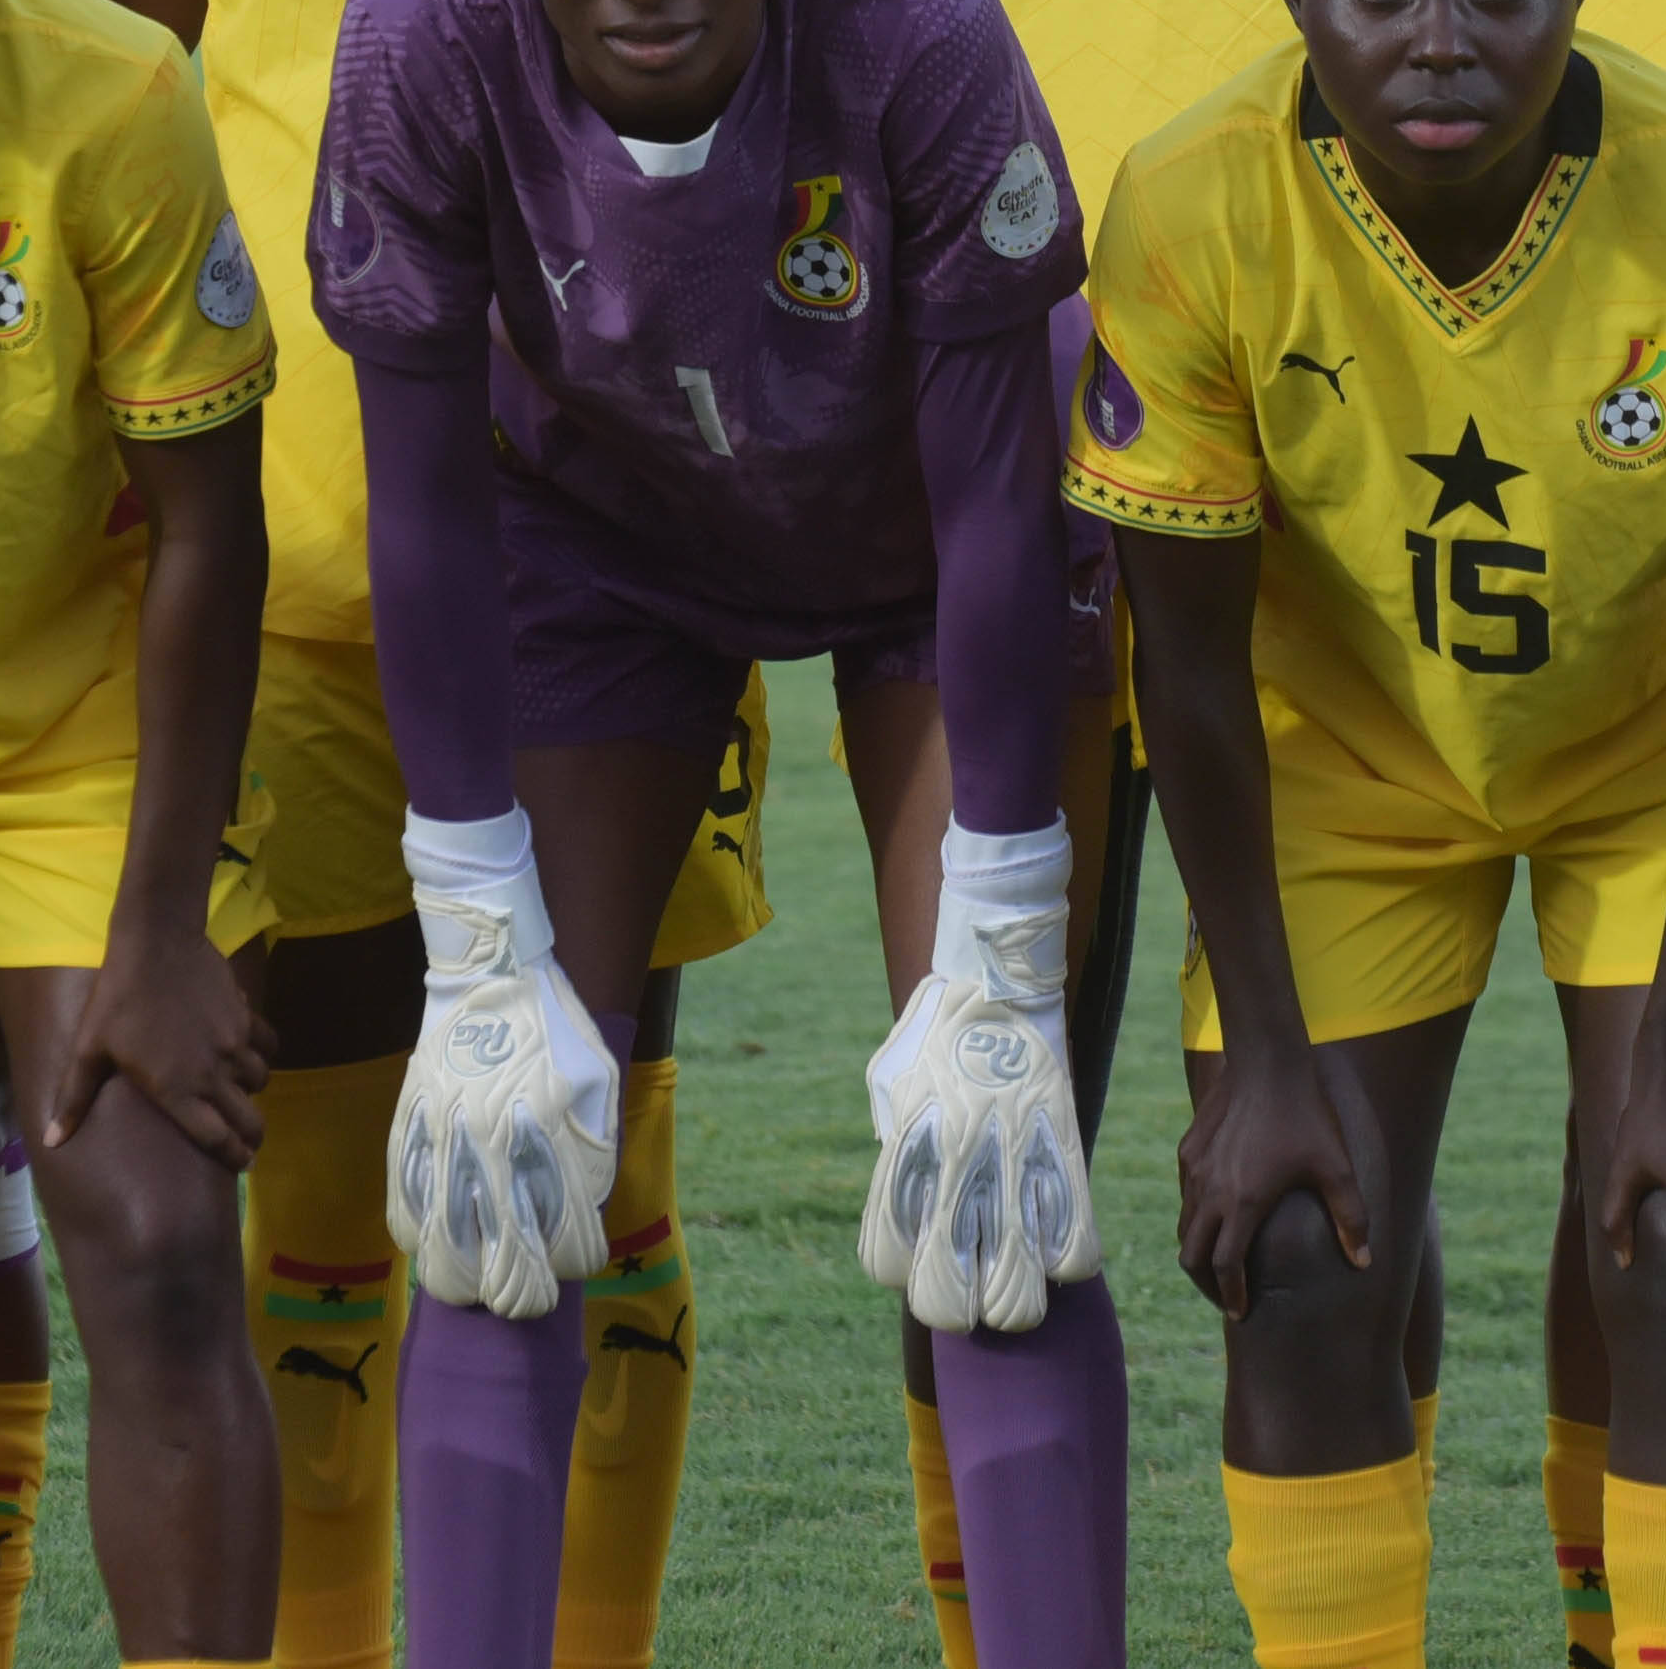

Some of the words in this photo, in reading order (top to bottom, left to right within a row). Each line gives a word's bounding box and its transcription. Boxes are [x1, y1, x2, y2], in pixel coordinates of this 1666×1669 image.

[764, 278, 790, 311] GHANA
[789, 304, 846, 322] FOOTBALL
[675, 365, 734, 459] 1
[1575, 418, 1595, 456] GHANA
[1592, 451, 1646, 471] FOOTBALL
[1405, 528, 1551, 676] 15
